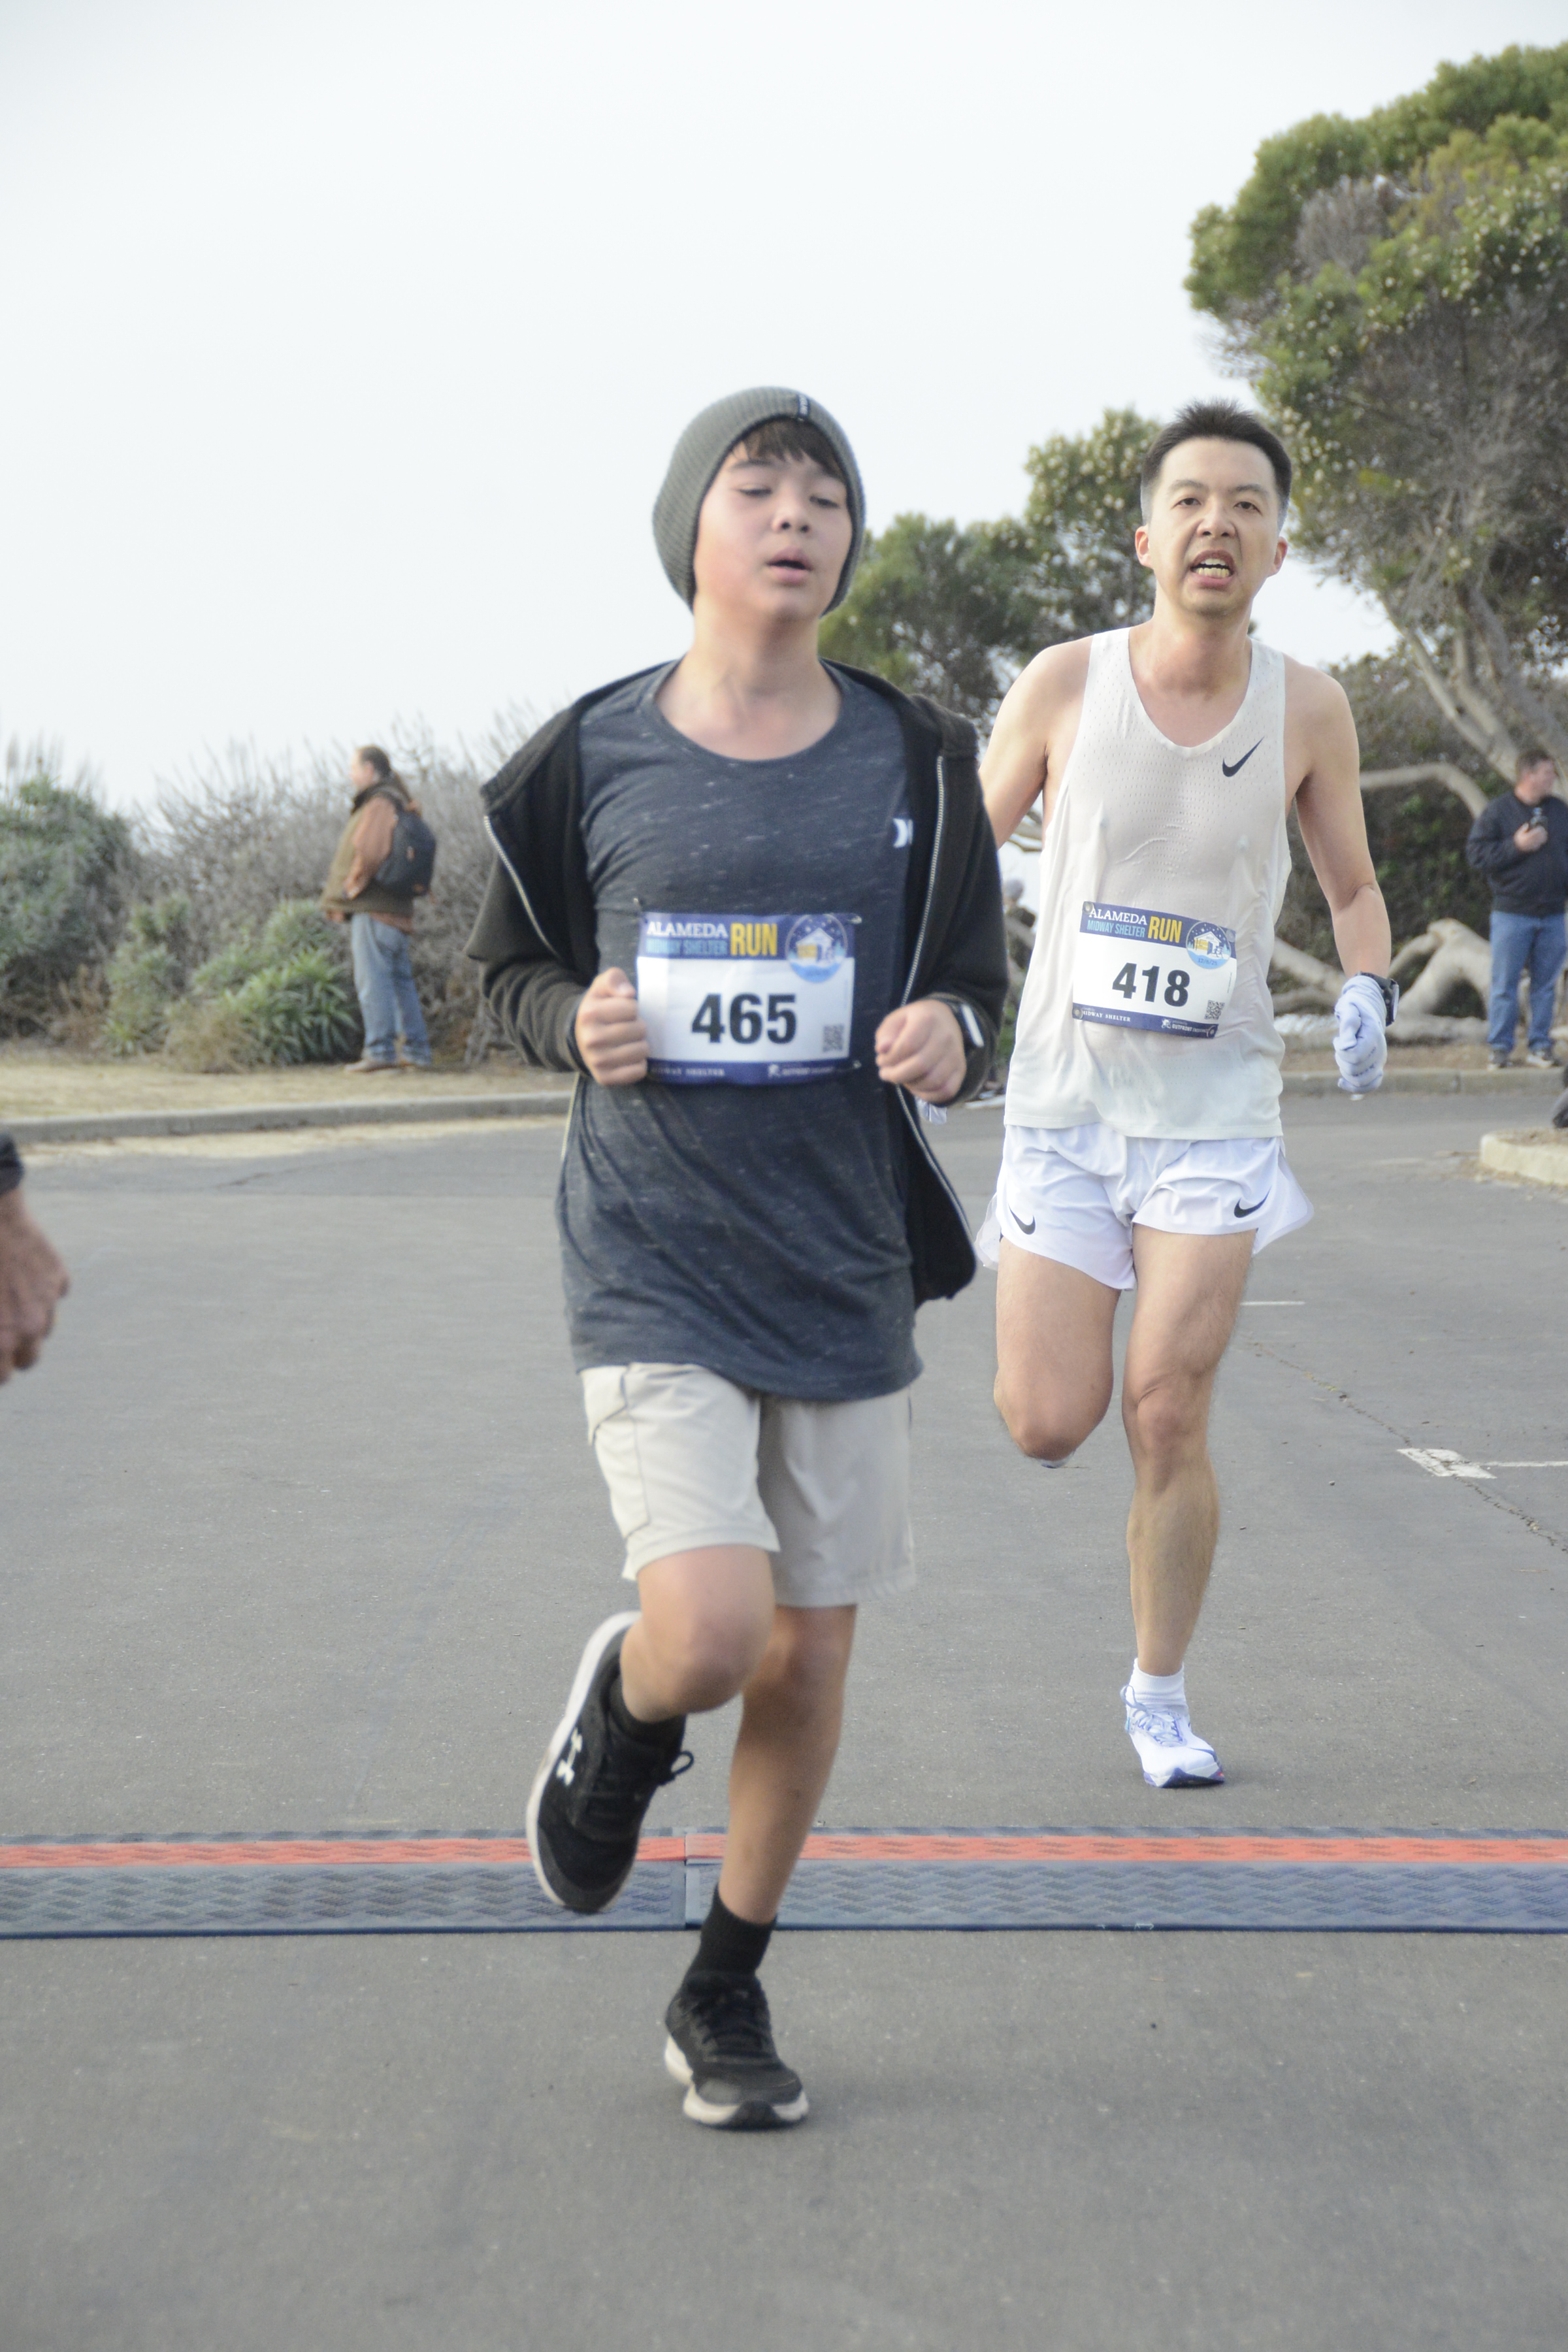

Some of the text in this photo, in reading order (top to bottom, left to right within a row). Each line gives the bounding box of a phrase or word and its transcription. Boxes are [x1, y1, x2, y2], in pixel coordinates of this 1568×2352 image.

[647, 921, 728, 938] ALAMEDA
[1087, 919, 1145, 938] MIDWAY SHELTER
[1089, 907, 1147, 925] ALAMEDA
[1148, 916, 1182, 943] RUN
[730, 923, 777, 956] RUN
[1112, 962, 1190, 1007] 418
[691, 993, 796, 1044] 465
